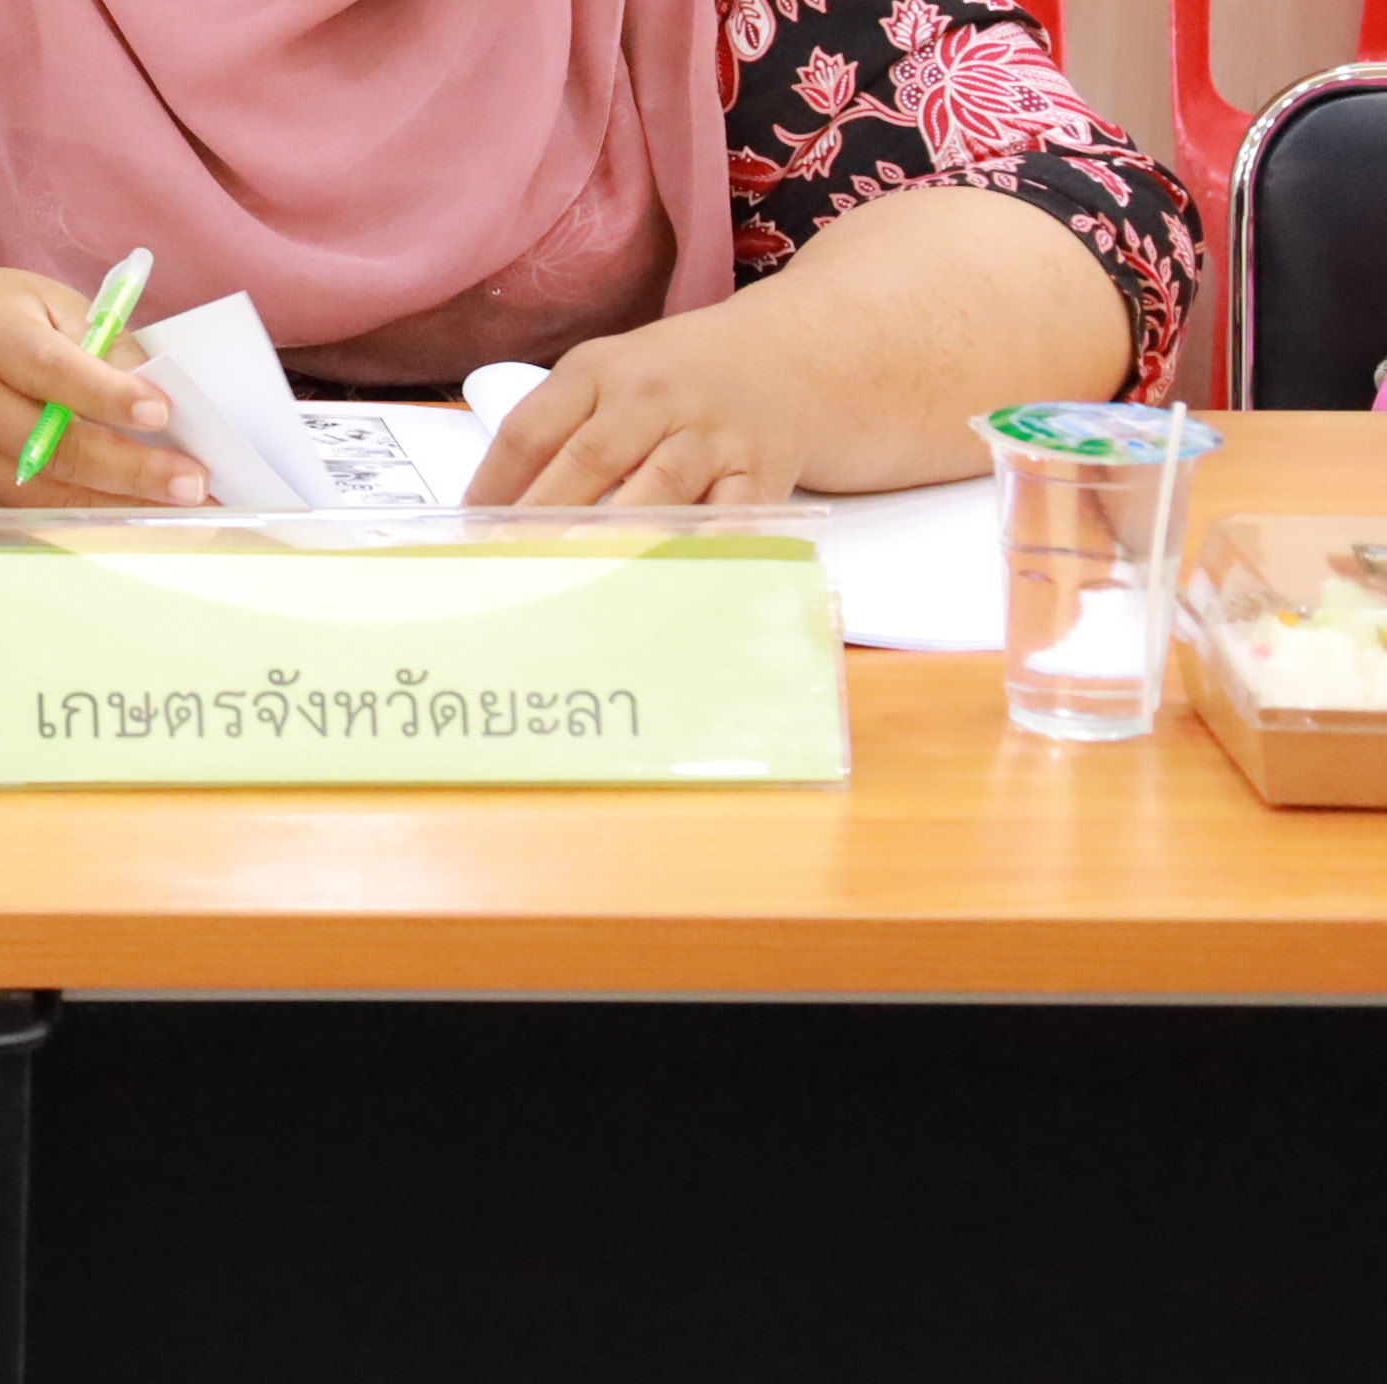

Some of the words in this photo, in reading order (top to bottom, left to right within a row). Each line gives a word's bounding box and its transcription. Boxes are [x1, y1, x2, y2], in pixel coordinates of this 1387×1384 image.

[37, 668, 639, 739] เกษตรจังหวัดยะลา
